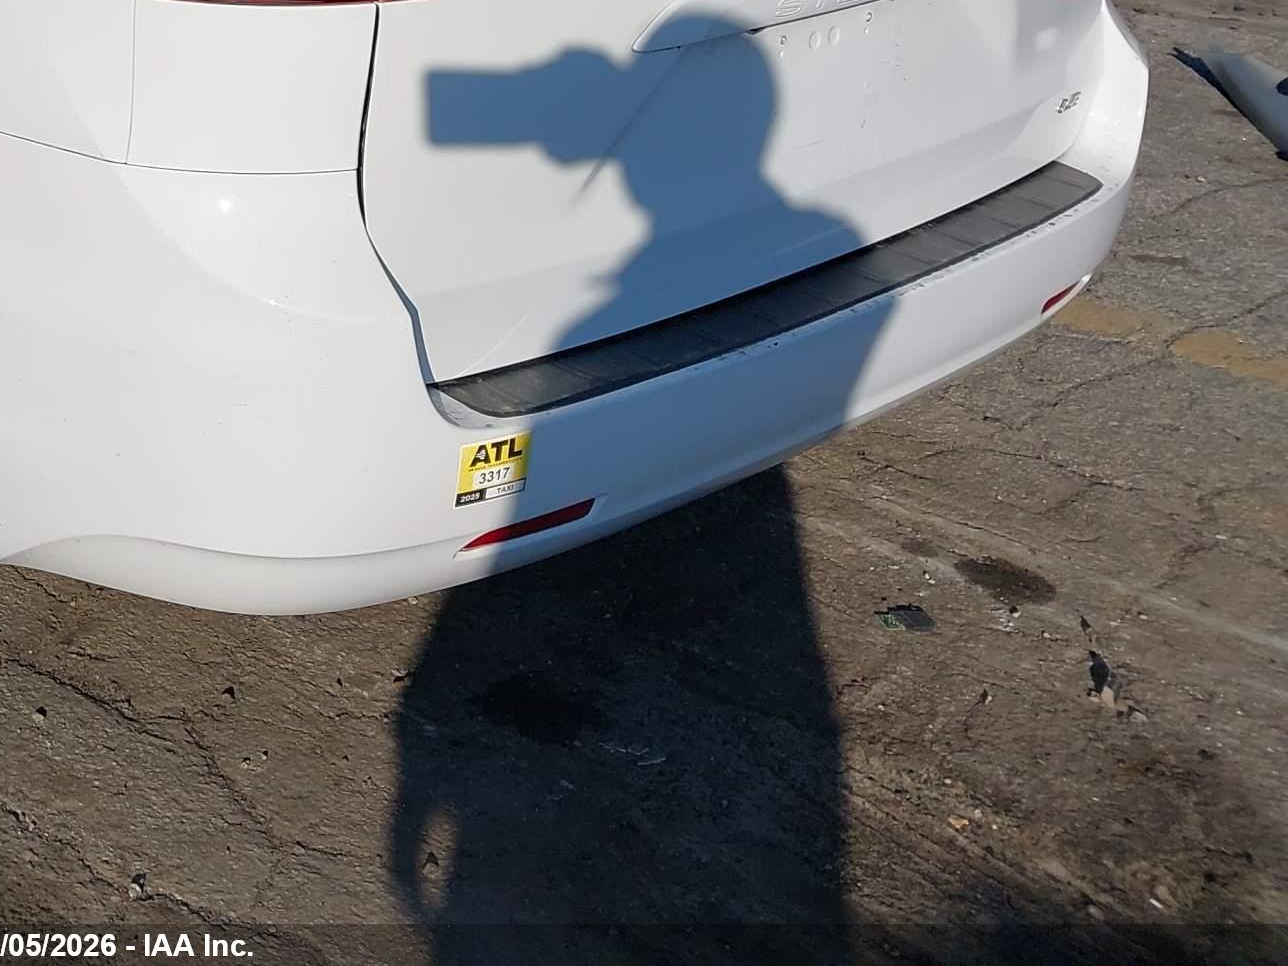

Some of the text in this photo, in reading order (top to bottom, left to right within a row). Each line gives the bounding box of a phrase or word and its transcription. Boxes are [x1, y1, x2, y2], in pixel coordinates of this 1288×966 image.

[469, 437, 524, 468] ATL
[479, 467, 511, 485] 3317
[460, 484, 515, 503] 2025 TAXI
